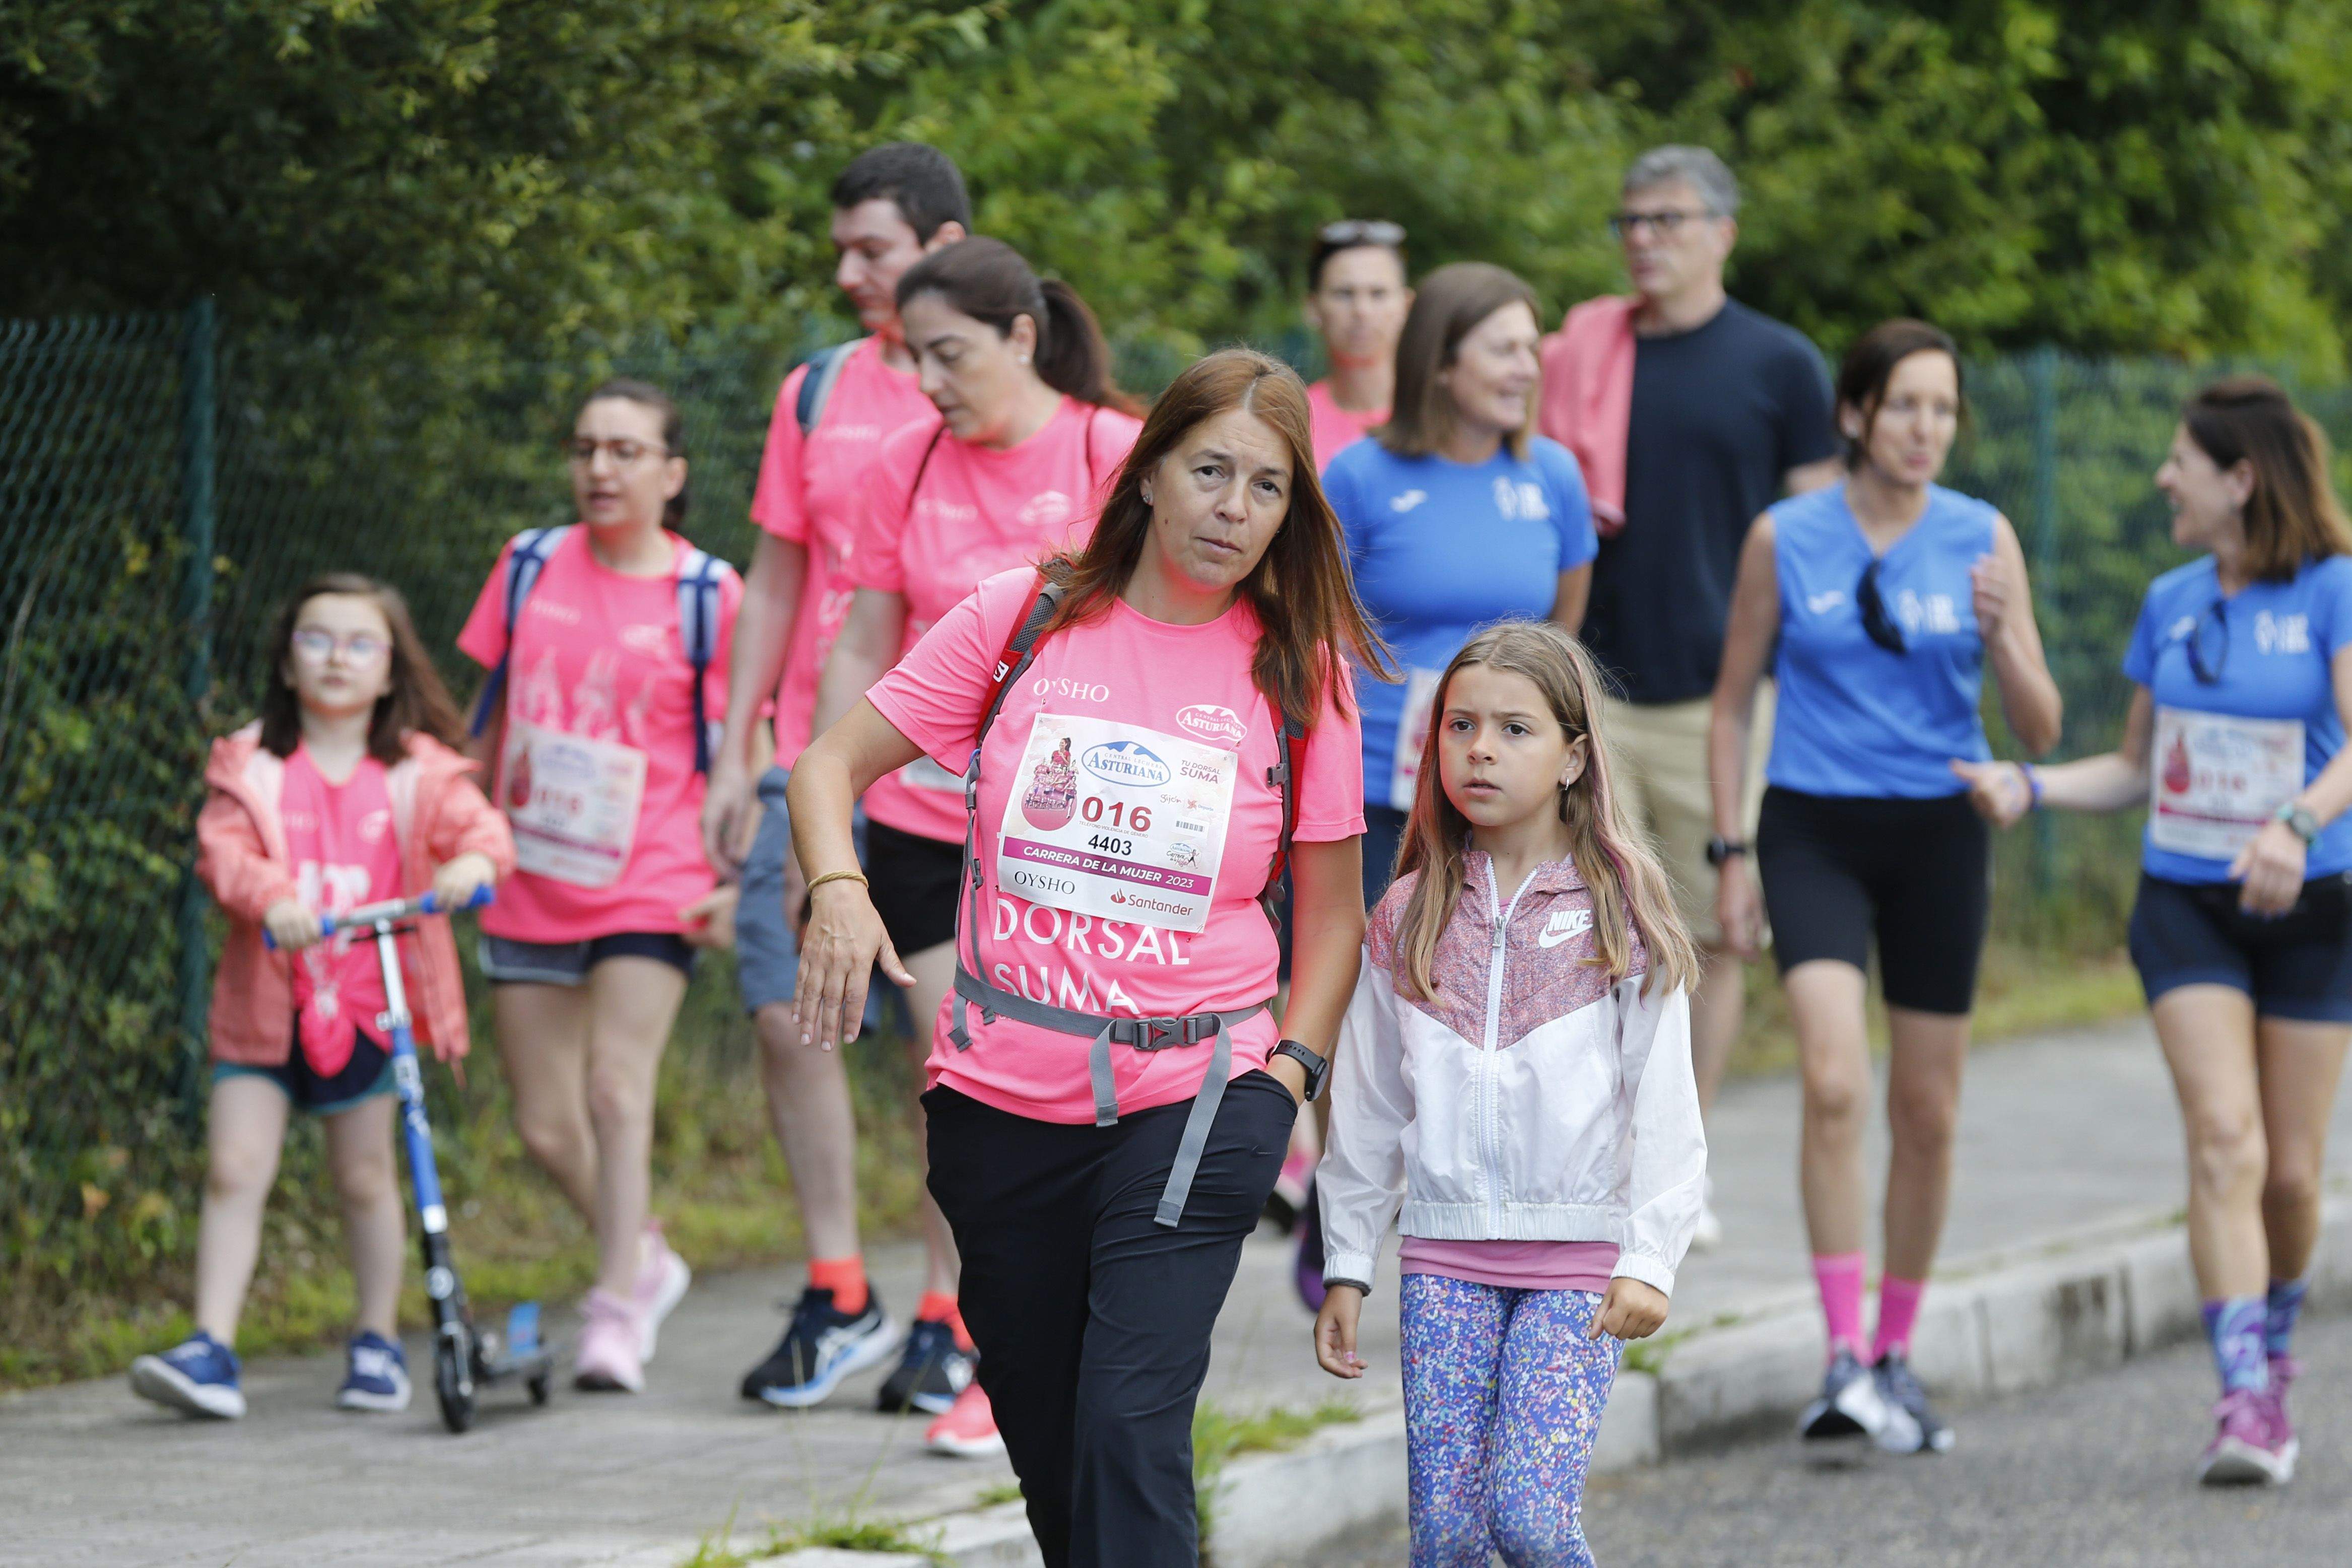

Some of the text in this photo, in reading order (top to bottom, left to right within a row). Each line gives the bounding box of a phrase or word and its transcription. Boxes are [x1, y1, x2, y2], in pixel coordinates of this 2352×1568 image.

[1181, 711, 1242, 738] ASTURIANA
[1088, 752, 1163, 781] ASTURIANA
[1104, 753, 1163, 769] CENTRAL LECHERA
[1192, 762, 1221, 775] DORSAL
[1180, 767, 1219, 784] SUMA
[1082, 796, 1152, 832] 016
[1088, 834, 1132, 856] 4403
[1023, 846, 1194, 889] CARRERA DE LA MUJER 2023
[1014, 870, 1076, 895] OYSHO
[1127, 895, 1193, 916] Santander
[993, 898, 1190, 965] DORSAL
[1547, 909, 1591, 932] NIKE
[994, 963, 1140, 1015] SUMA
